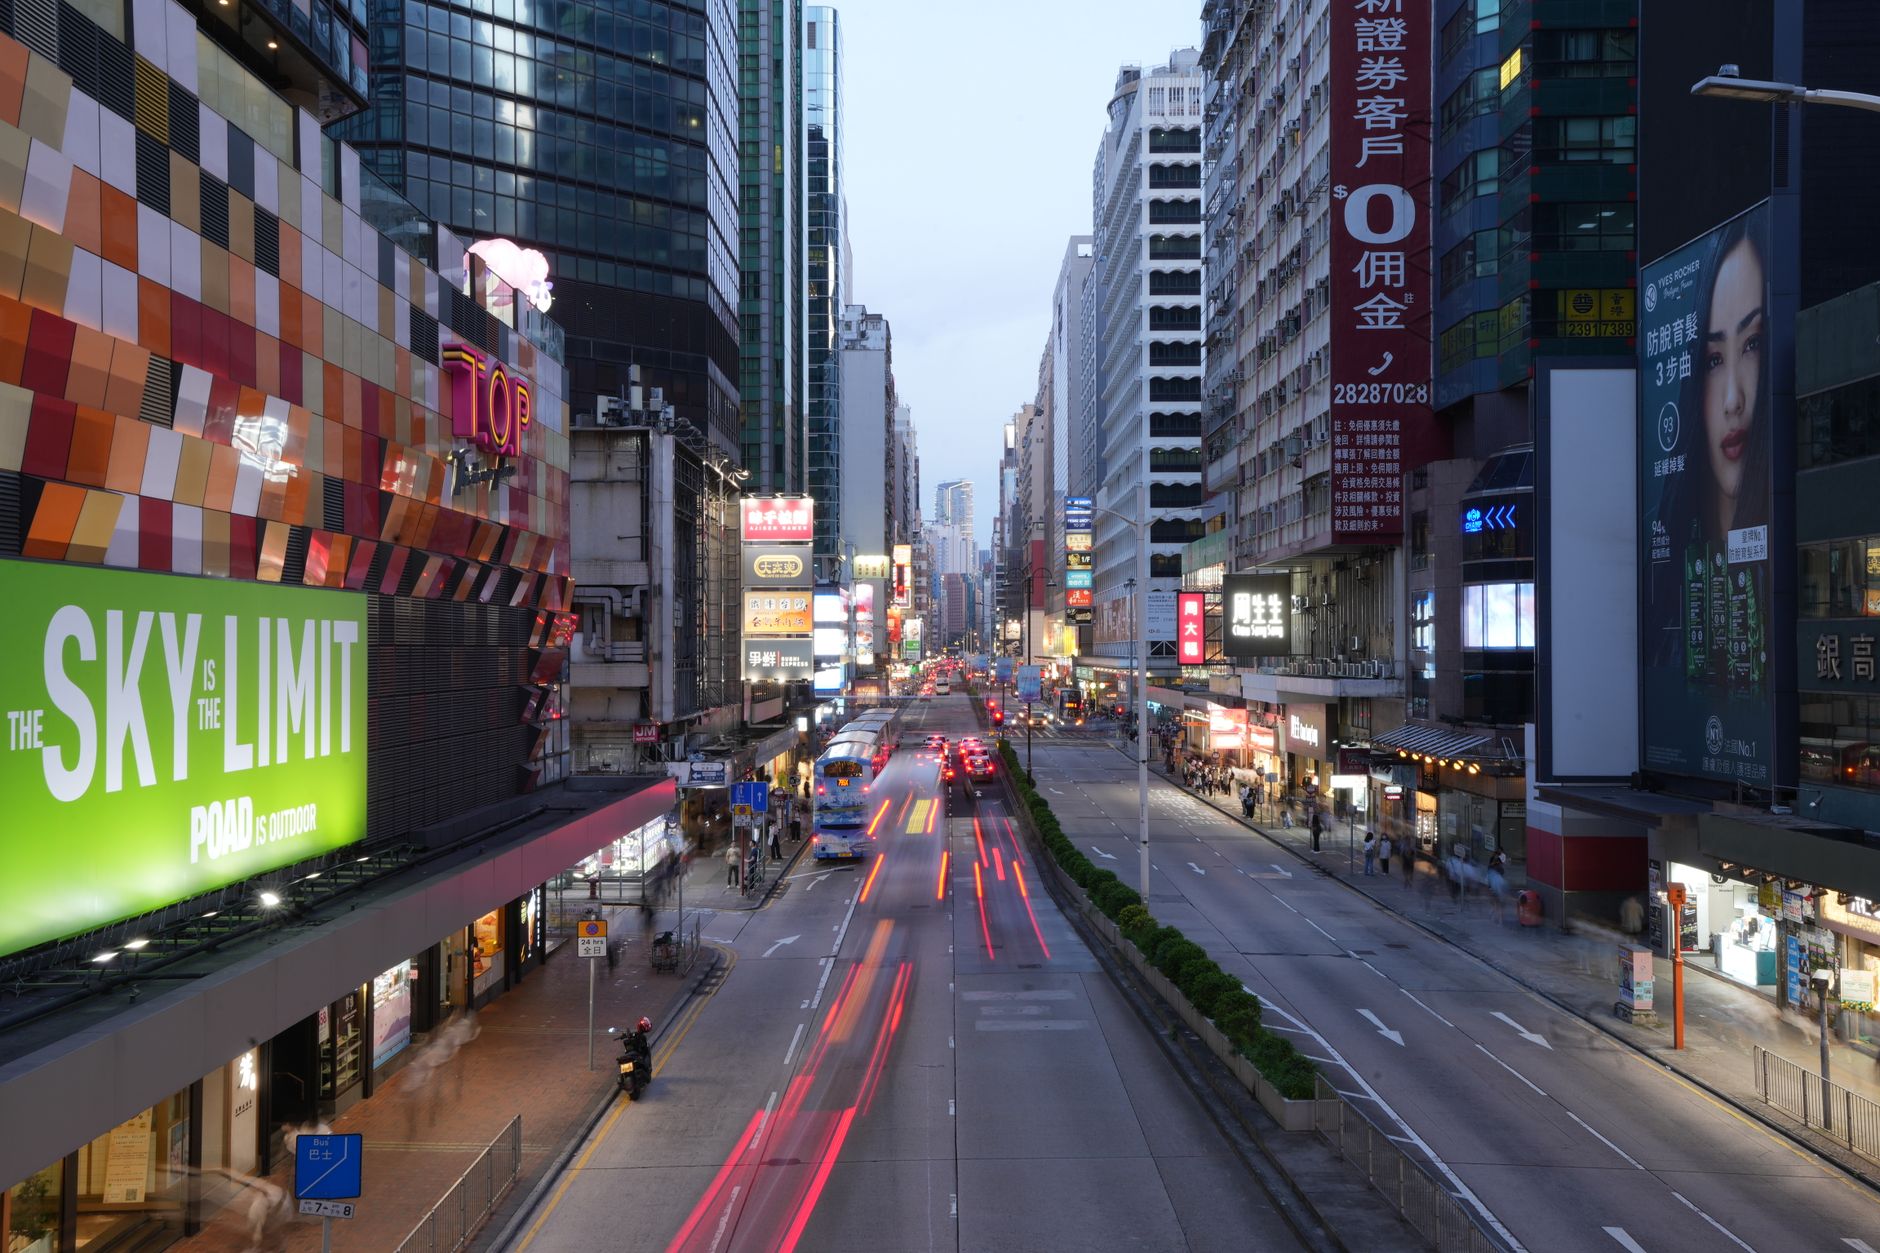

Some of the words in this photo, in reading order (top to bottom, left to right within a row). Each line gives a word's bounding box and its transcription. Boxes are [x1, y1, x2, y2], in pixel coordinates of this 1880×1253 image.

[1658, 271, 1673, 289] YVES
[1674, 259, 1700, 281] ROCHER
[1352, 250, 1409, 330] 佣金
[1568, 323, 1598, 336] 2391
[1602, 323, 1633, 336] 7389
[1333, 383, 1428, 404] 28287028
[1663, 416, 1674, 434] 93
[1233, 593, 1283, 623] 周生生
[203, 659, 216, 691] IS
[42, 604, 202, 802] SKY
[223, 615, 359, 773] LIMIT
[197, 697, 221, 731] THE
[8, 709, 44, 751] THE
[636, 725, 656, 737] JM
[190, 796, 253, 864] POAD
[255, 815, 267, 847] IS
[269, 803, 317, 840] OUTDOOR
[583, 946, 601, 955] 全日
[309, 1148, 333, 1161] 巴士
[313, 1138, 329, 1146] Bus
[315, 1202, 322, 1213] 7
[343, 1205, 351, 1216] 8
